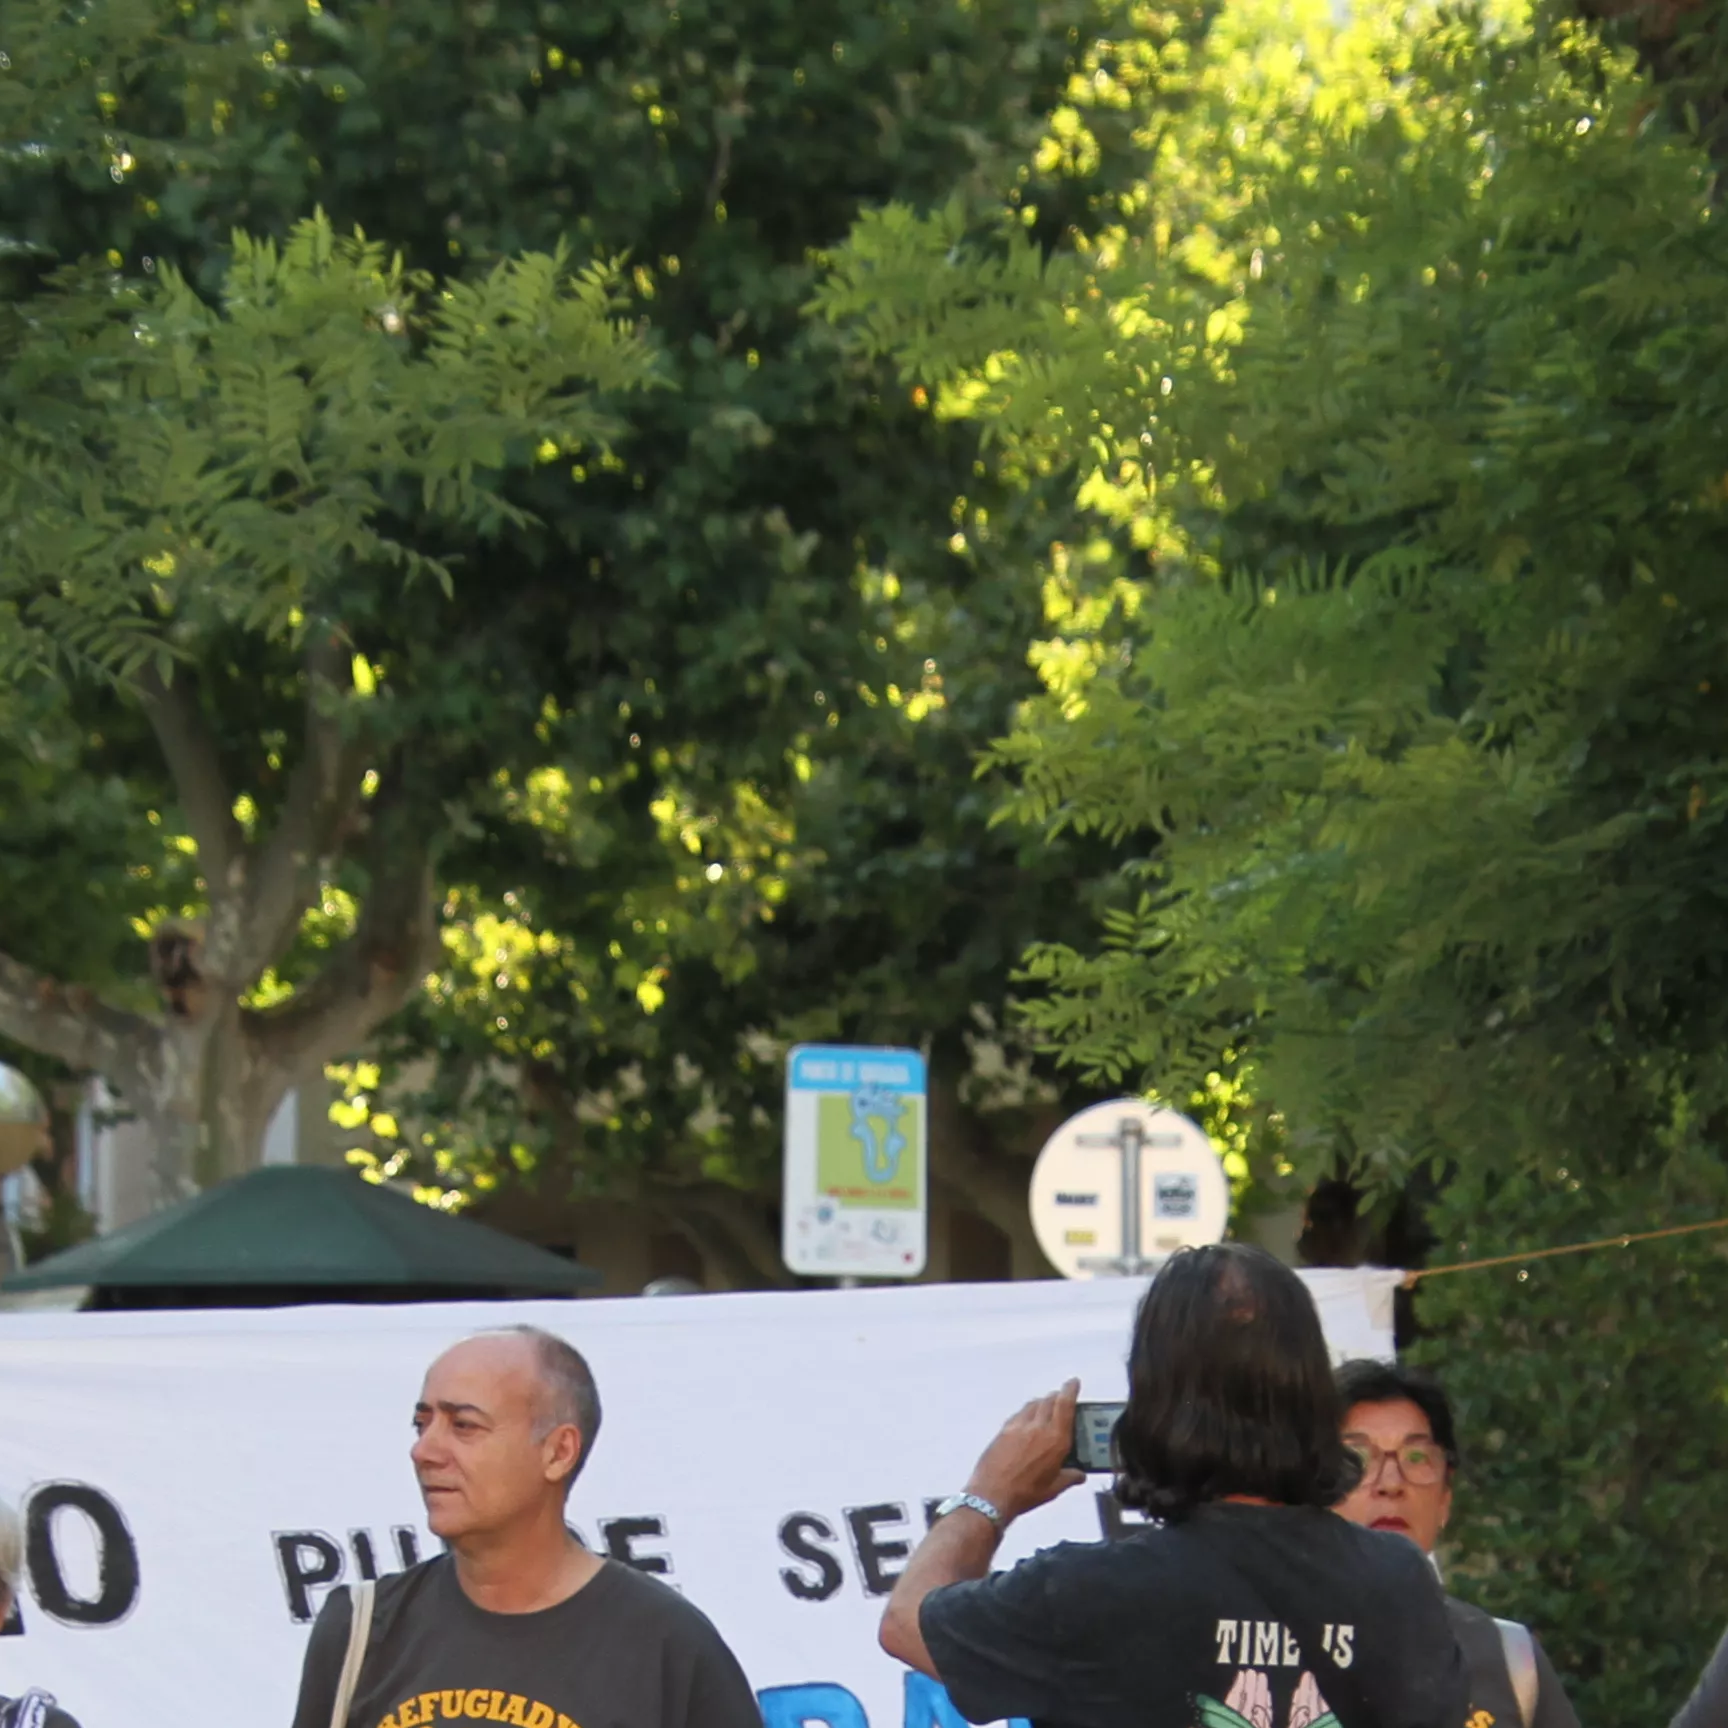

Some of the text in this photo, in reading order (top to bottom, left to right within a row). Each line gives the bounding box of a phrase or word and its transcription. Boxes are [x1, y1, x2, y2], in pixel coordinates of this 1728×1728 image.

[0, 1479, 141, 1634] O
[777, 1495, 944, 1602] SE
[1216, 1619, 1300, 1666] TIME
